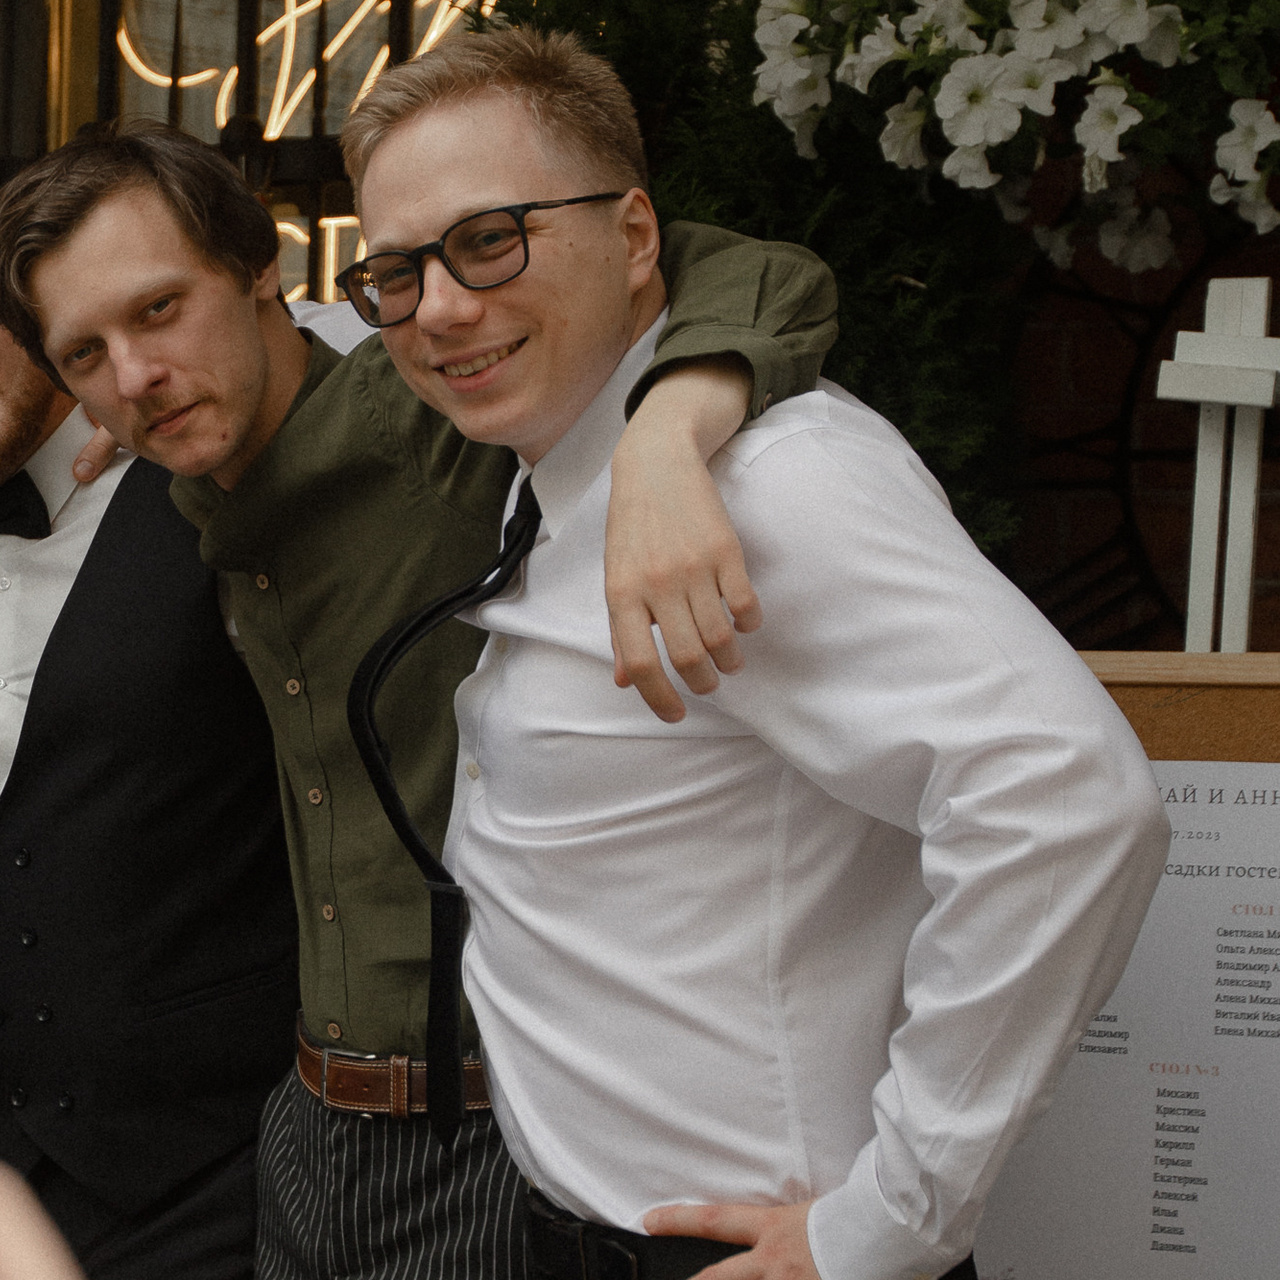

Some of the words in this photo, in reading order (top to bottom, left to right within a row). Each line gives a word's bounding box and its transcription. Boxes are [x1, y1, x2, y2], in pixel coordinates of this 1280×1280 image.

[1158, 784, 1198, 803] АЙ
[1208, 788, 1224, 804] И
[1226, 866, 1280, 879] госте
[1217, 927, 1264, 939] Светлана
[1216, 943, 1246, 955] Ольга
[1216, 960, 1270, 974] Владимир
[1215, 977, 1272, 991] Александр
[1215, 993, 1247, 1004] Алена
[1215, 1009, 1260, 1022] Виталий
[1214, 1025, 1245, 1037] Елена
[1078, 1043, 1128, 1055] Елизавета
[1156, 1088, 1200, 1100] Михаил
[1156, 1104, 1206, 1117] Кристина
[1155, 1121, 1200, 1133] Максим
[1155, 1138, 1195, 1152] Кирилл
[1154, 1155, 1192, 1169] Герман
[1153, 1172, 1208, 1187] Екатерина
[1153, 1189, 1199, 1202] Алексей
